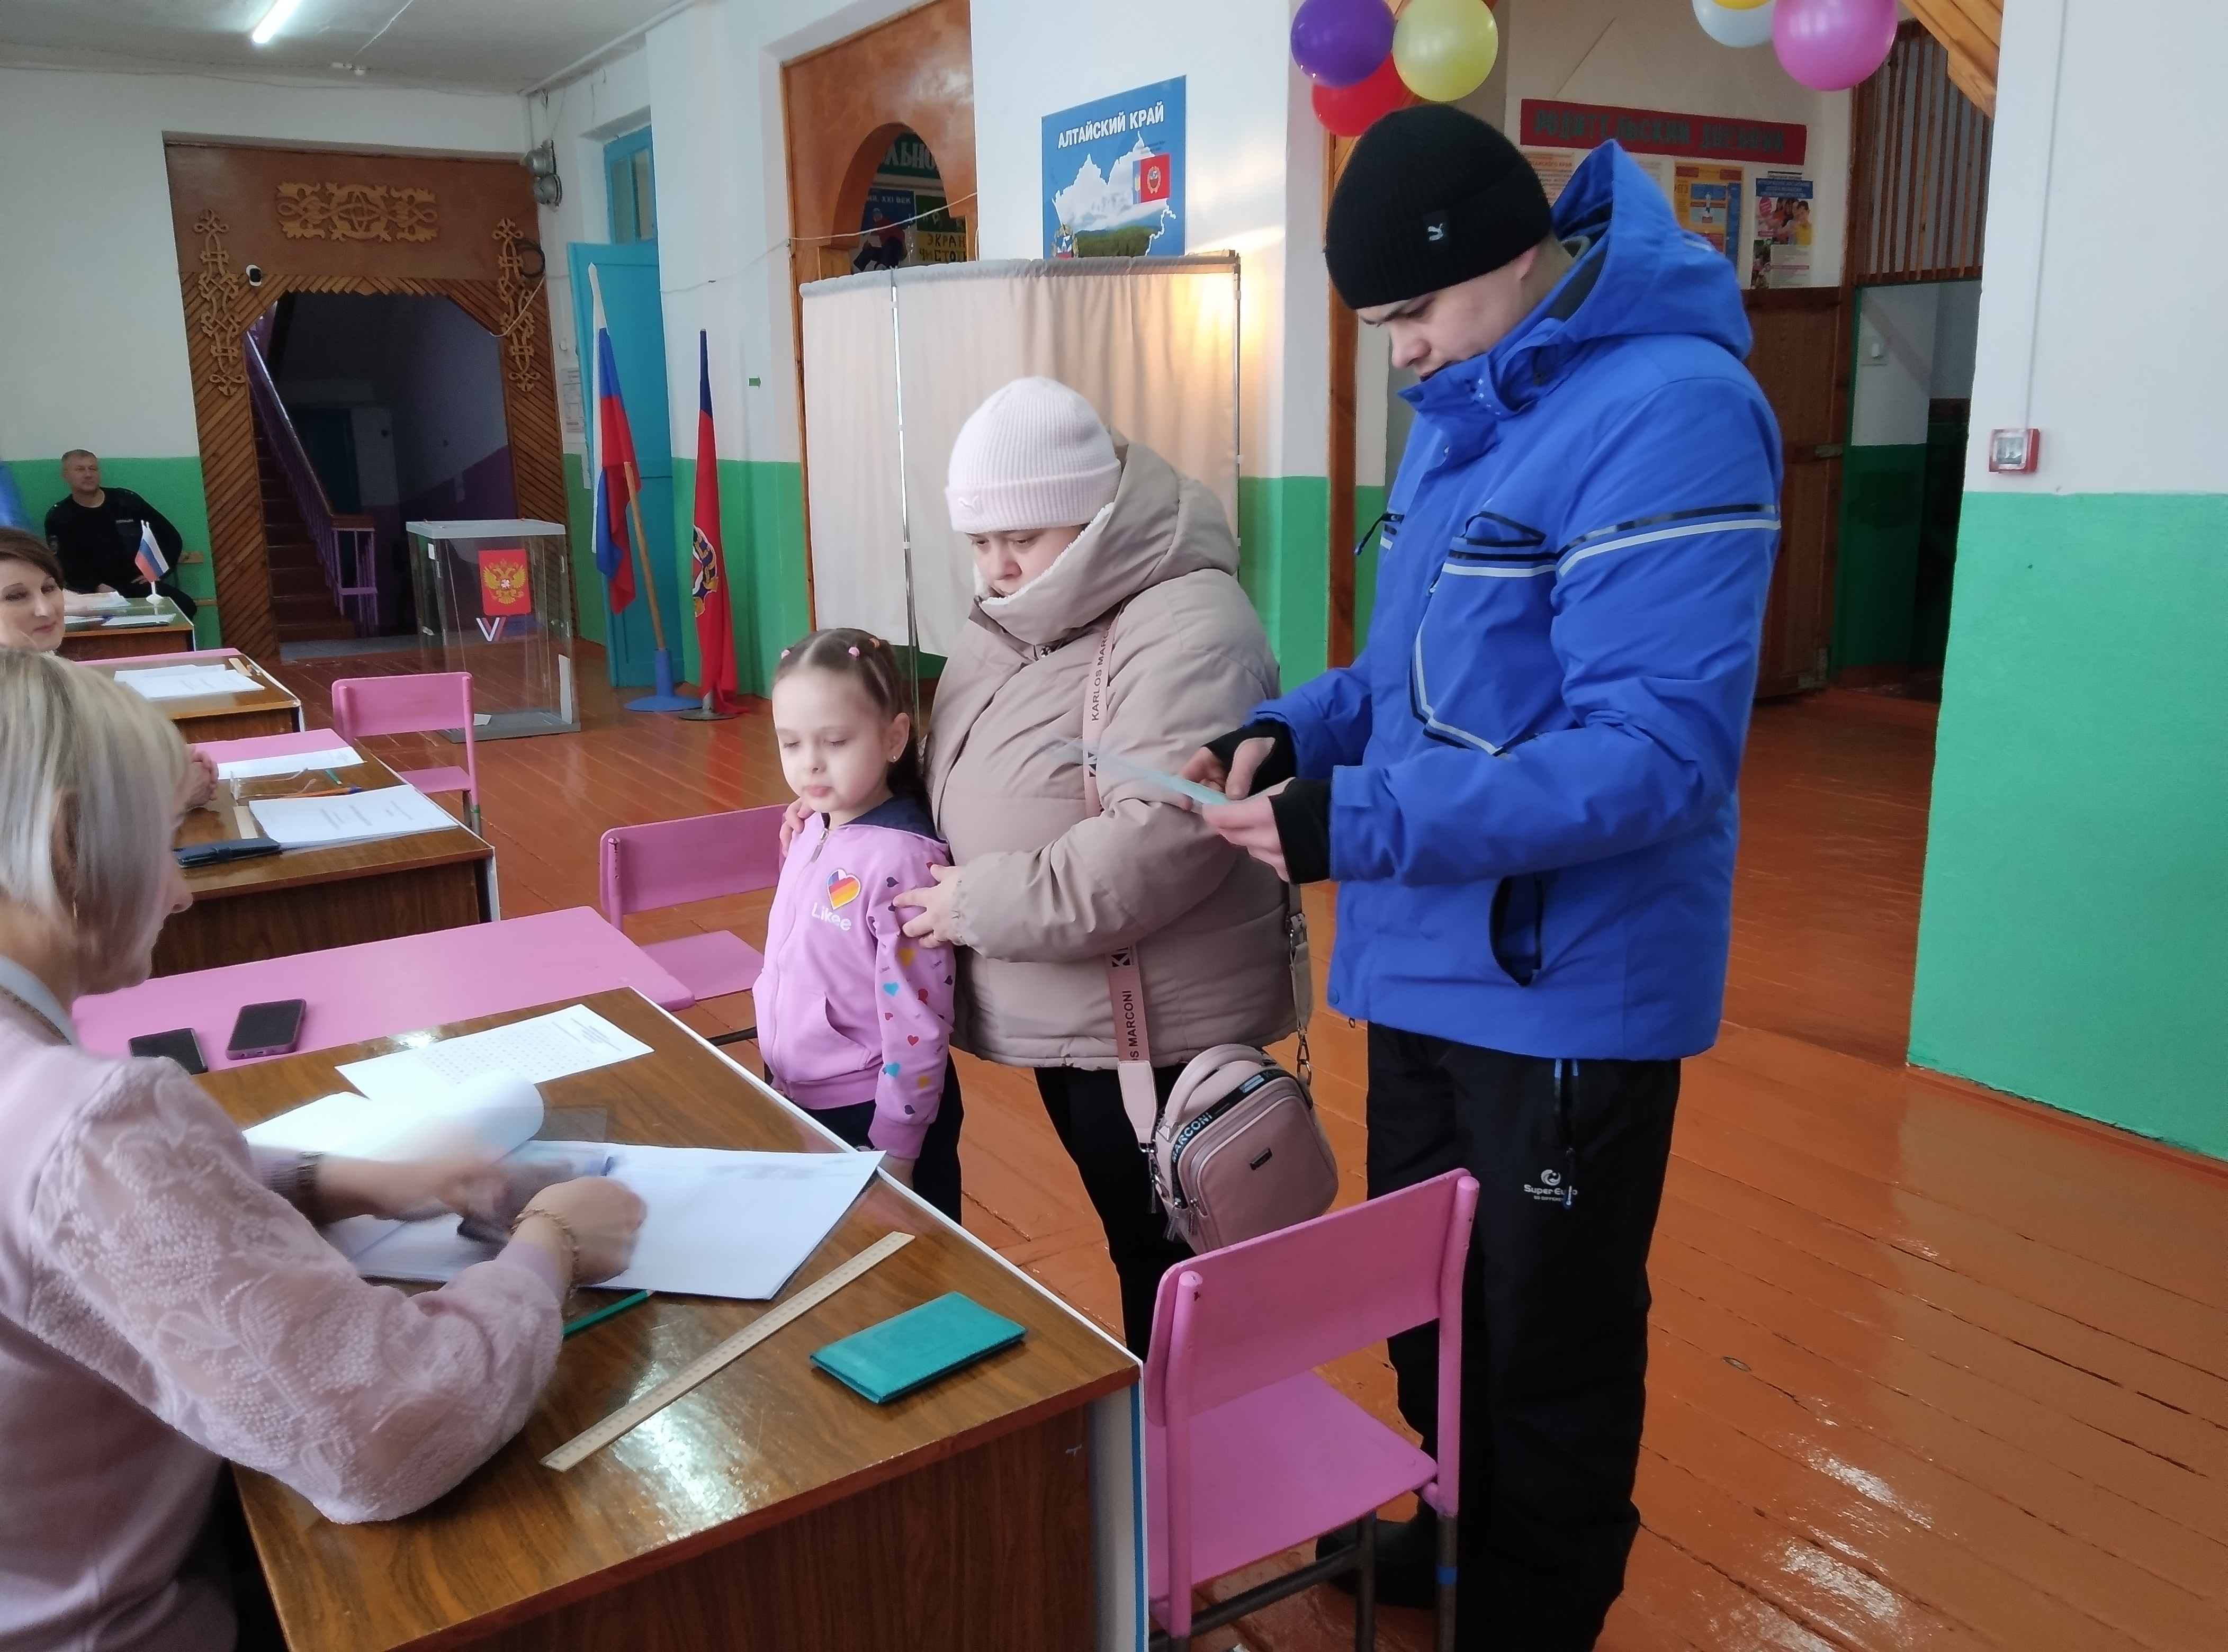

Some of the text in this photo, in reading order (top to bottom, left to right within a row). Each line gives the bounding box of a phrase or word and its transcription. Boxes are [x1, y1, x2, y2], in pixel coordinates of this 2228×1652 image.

[1058, 101, 1164, 149] АЛТАЙСКИЙ КРАЙ
[927, 233, 966, 247] ЭКРАН
[1091, 669, 1102, 722] KARLOS
[812, 902, 851, 931] Likee
[1122, 990, 1138, 1047] MARCONI
[1172, 1112, 1212, 1163] MARCONI
[1524, 1184, 1553, 1195] Super
